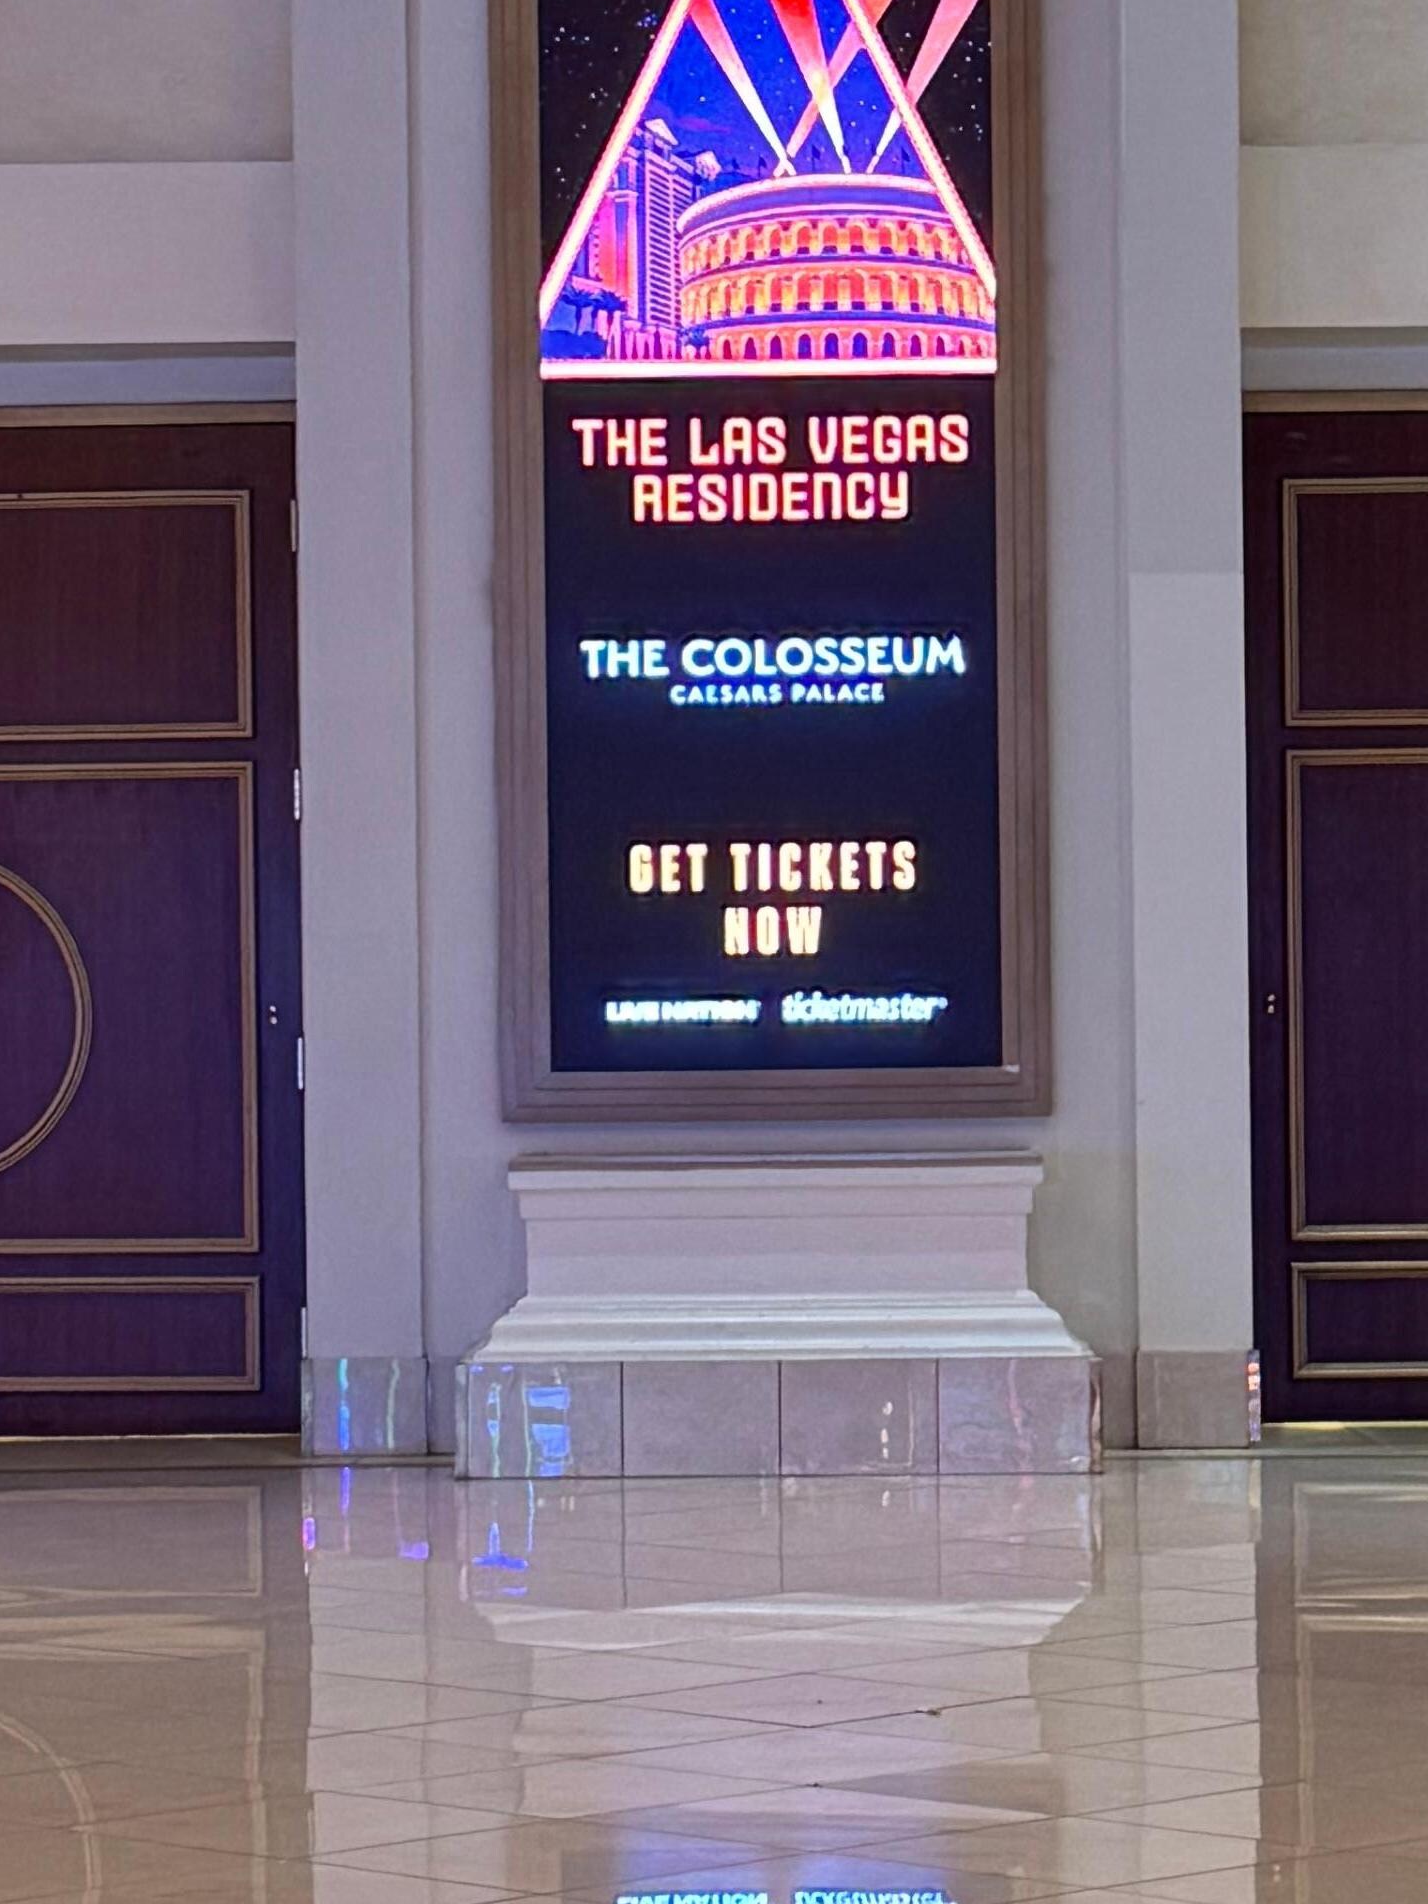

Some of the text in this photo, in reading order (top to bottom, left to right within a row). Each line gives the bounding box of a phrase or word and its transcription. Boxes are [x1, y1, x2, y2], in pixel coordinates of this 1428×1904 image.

[572, 415, 969, 466] THE LAS VEGAS
[634, 472, 908, 521] RESIDENCY
[580, 636, 965, 678] THE COLOSSEUM
[670, 683, 884, 705] CAESARS PALACE
[629, 841, 916, 893] GET TICKETS
[724, 906, 822, 955] NOW
